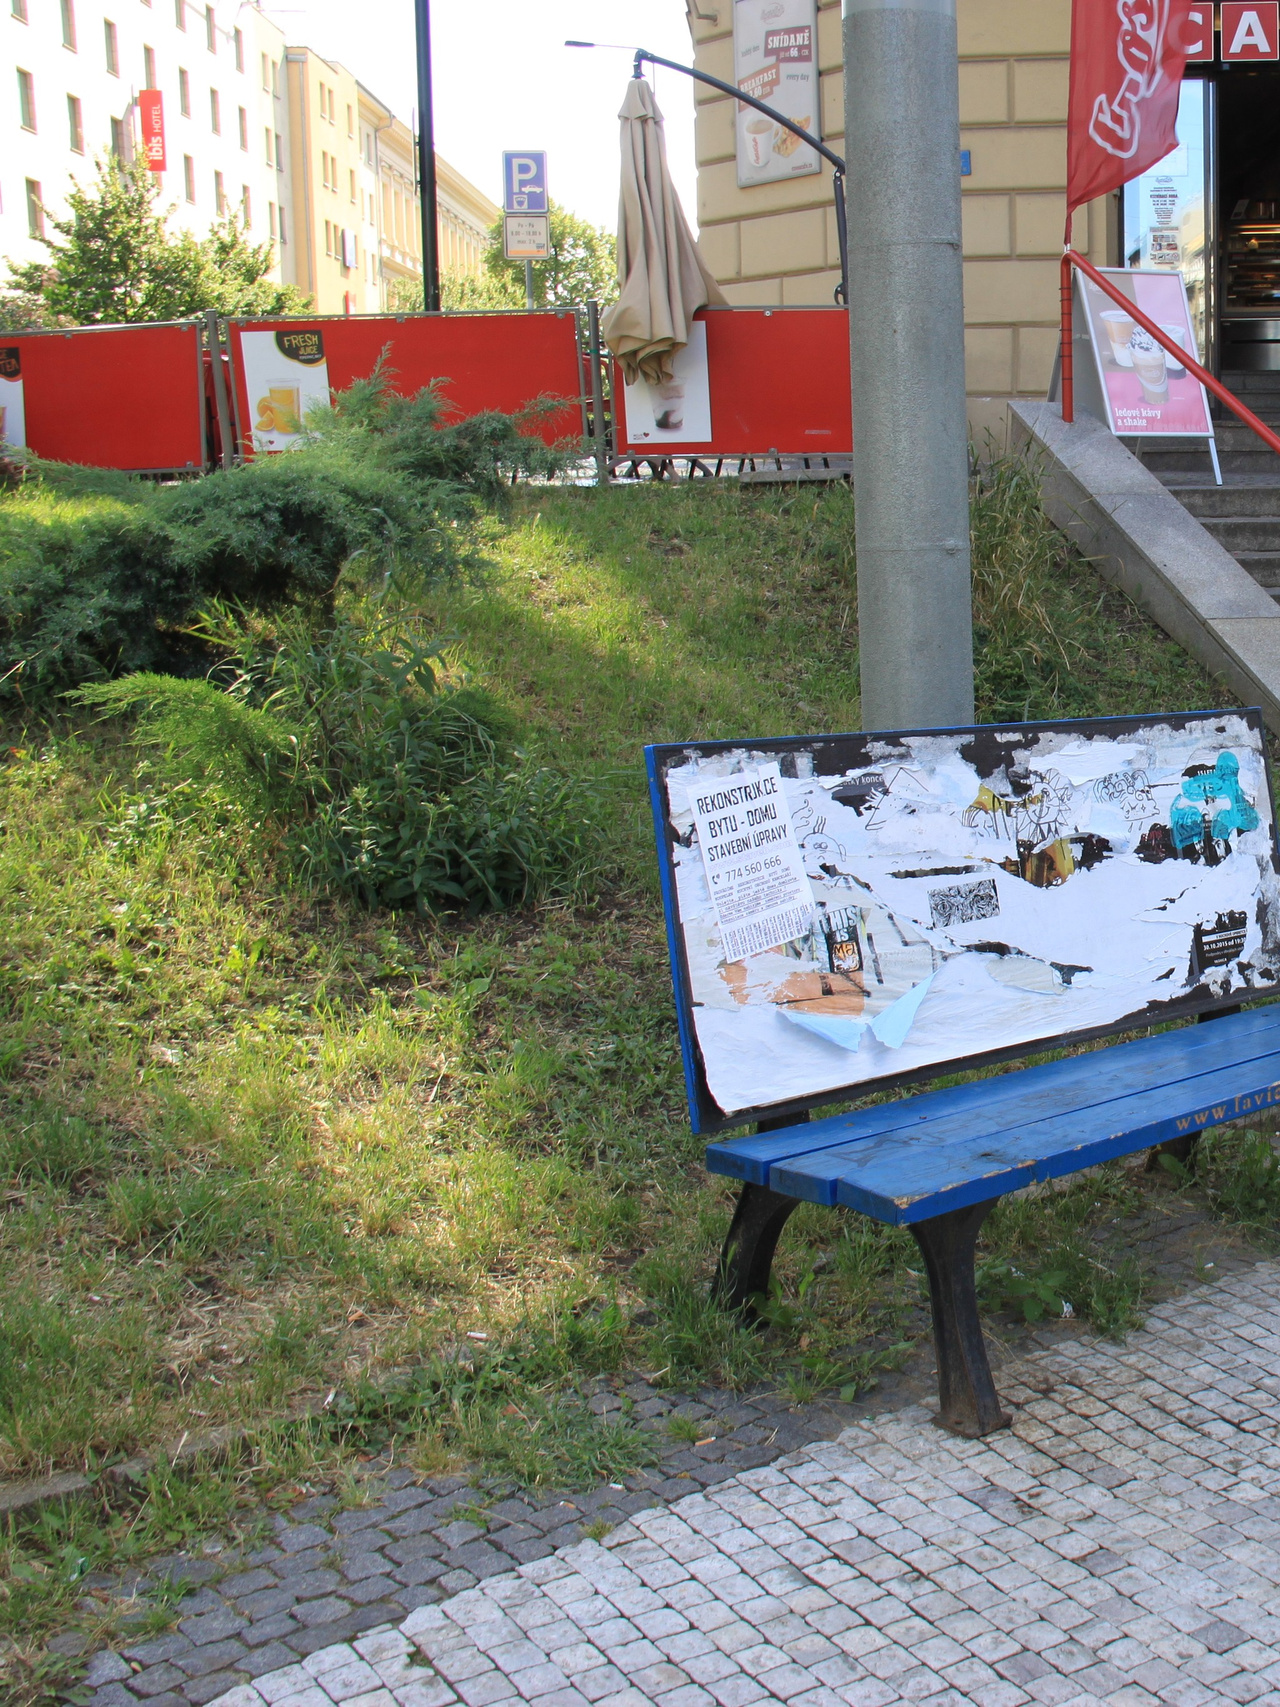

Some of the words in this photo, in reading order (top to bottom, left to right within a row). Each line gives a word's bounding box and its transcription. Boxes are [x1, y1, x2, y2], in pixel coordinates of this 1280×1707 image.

[767, 29, 809, 49] SNÍDANĚ
[739, 69, 776, 93] BREAKFAST
[800, 74, 809, 82] day
[152, 104, 162, 133] HOTEL
[148, 136, 164, 160] ibis
[512, 158, 537, 193] P
[283, 334, 318, 348] FRESH
[298, 345, 318, 355] JUICE
[1115, 408, 1140, 417] ledové
[1142, 408, 1161, 418] kávy
[1124, 417, 1147, 426] shake
[708, 814, 738, 838] BYTU
[747, 803, 777, 827] DOMU
[708, 832, 752, 861] STAVEBNÍ
[752, 824, 788, 847] ÚPRAVY
[725, 867, 743, 882] 774
[745, 861, 762, 876] 560
[764, 855, 781, 870] 666
[818, 906, 857, 933] THIS
[836, 929, 849, 942] IS
[1203, 941, 1227, 951] 30.10.2015
